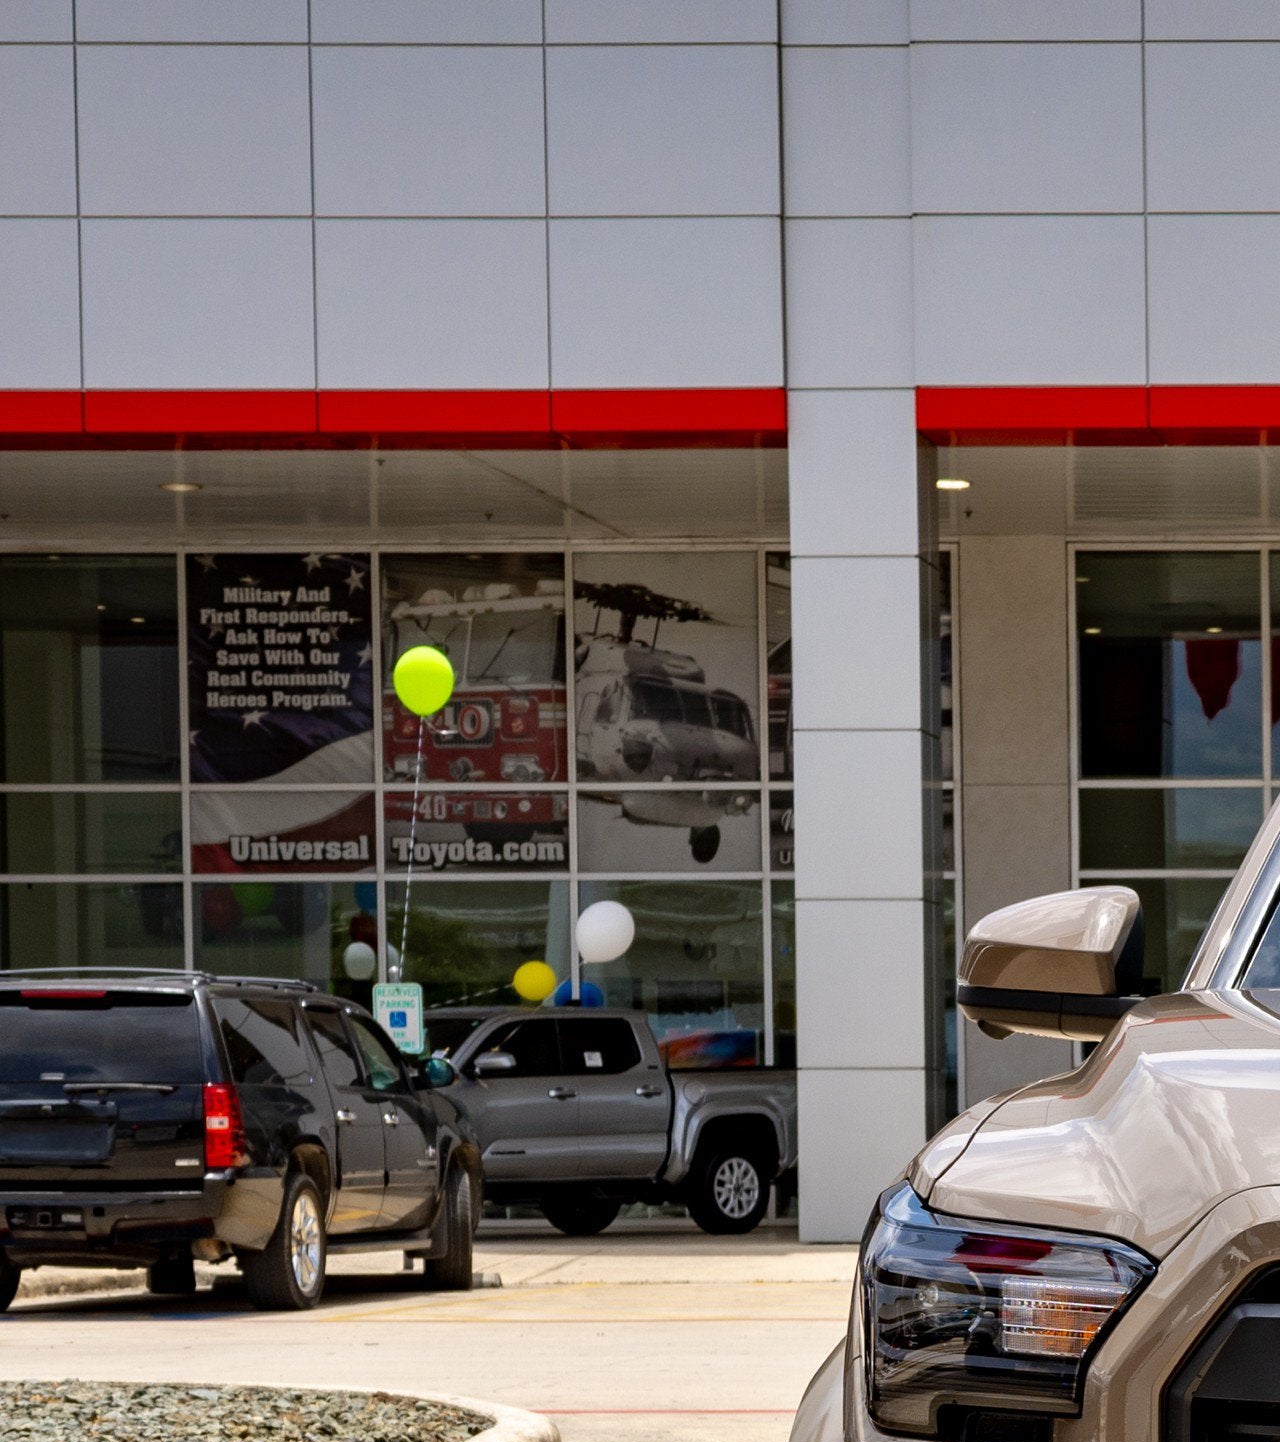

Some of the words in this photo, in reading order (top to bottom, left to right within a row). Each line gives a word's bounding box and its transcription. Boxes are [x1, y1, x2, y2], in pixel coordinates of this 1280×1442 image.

[223, 587, 292, 606] Military
[296, 586, 331, 603] And
[200, 608, 240, 624] First
[225, 628, 258, 645] Ask
[263, 628, 302, 645] How
[306, 628, 331, 644] To
[216, 650, 260, 666] Save
[265, 649, 305, 665] With
[309, 649, 341, 666] Our
[207, 671, 247, 687] Real
[251, 670, 350, 689] Community
[206, 691, 267, 708] Heroes
[272, 691, 352, 711] Program.
[419, 795, 446, 820] 40
[229, 835, 371, 863] Universal
[392, 837, 564, 872] Toyota.com
